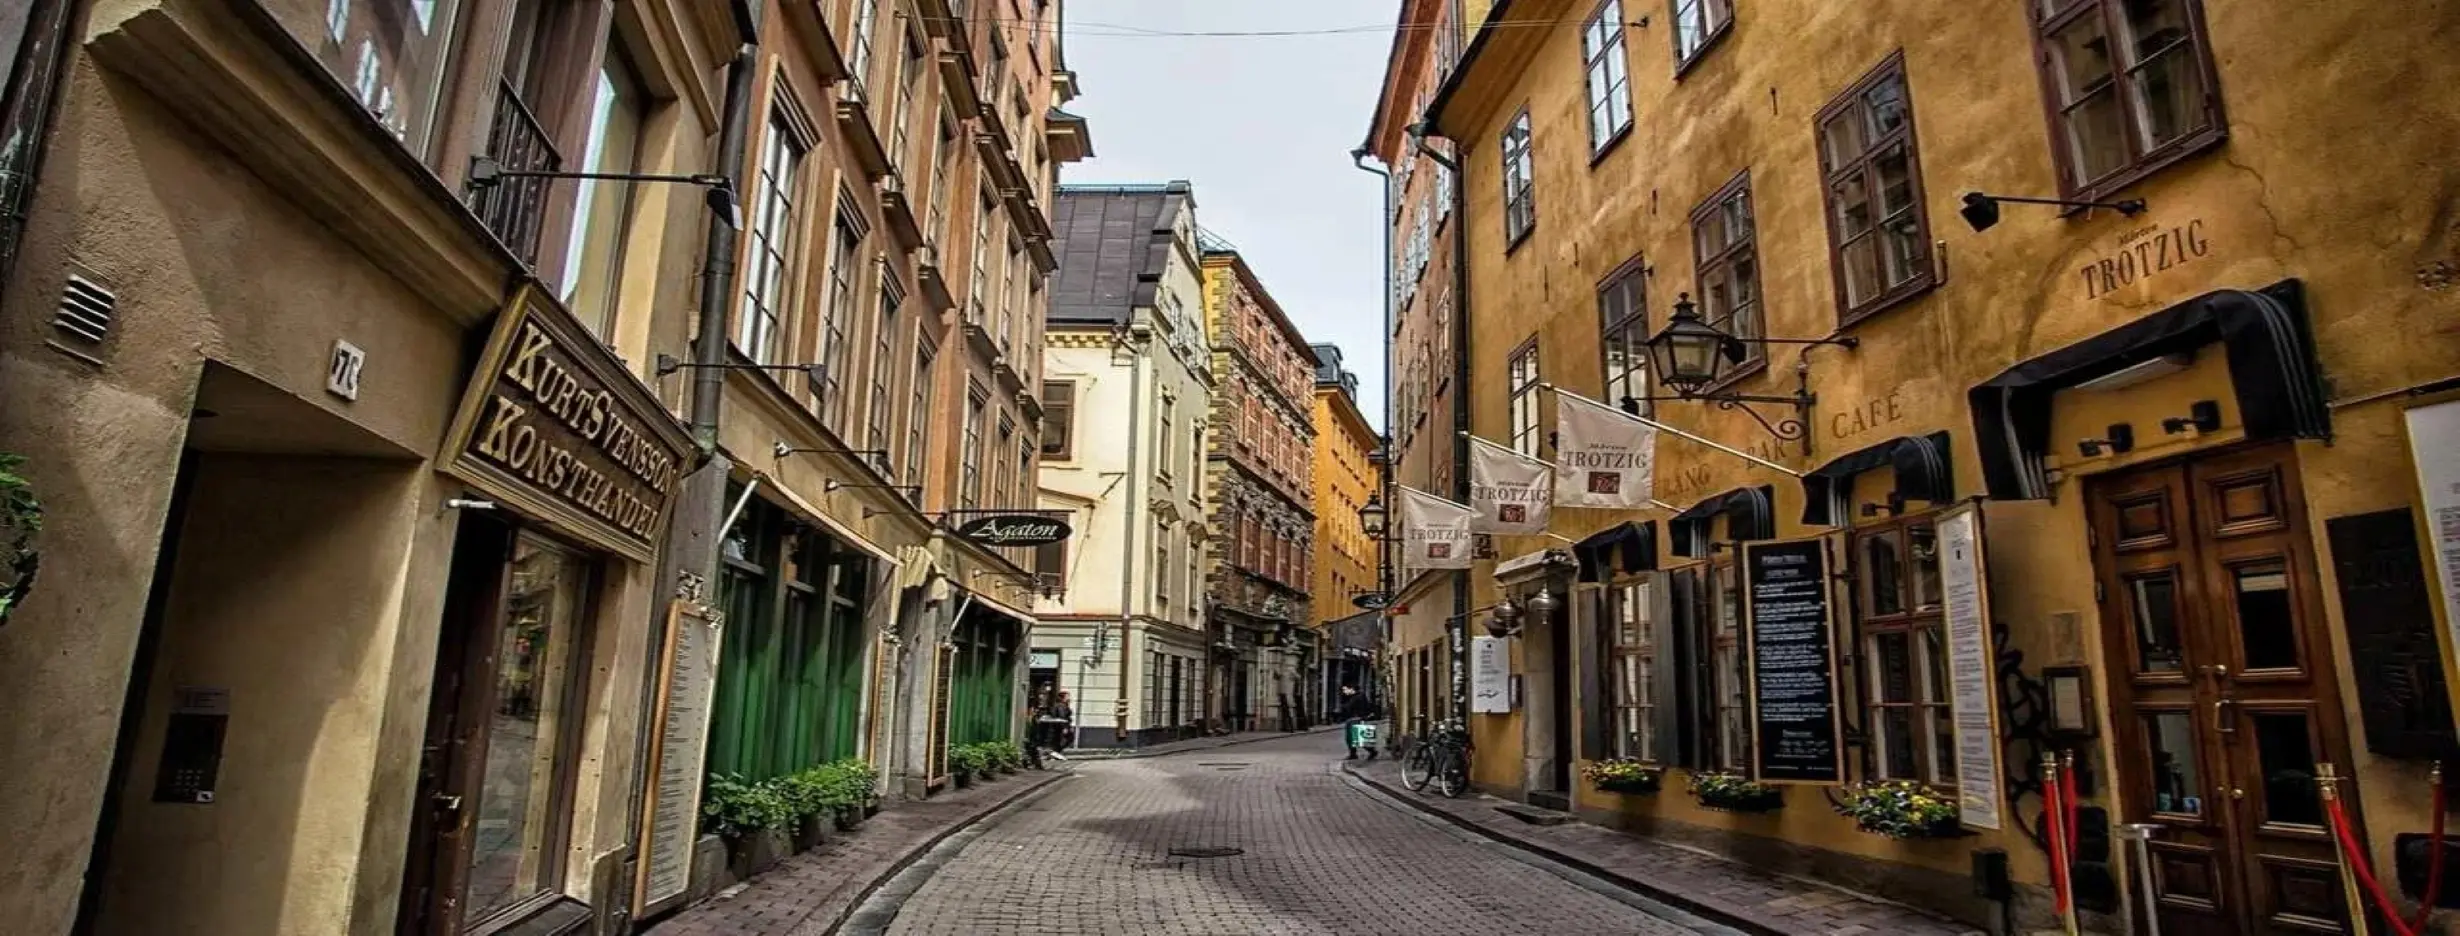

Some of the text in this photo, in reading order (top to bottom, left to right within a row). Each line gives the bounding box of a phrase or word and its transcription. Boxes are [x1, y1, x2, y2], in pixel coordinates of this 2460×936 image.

[2080, 218, 2208, 300] TROTZIG
[479, 395, 658, 537] KONSTHANDEL
[1563, 451, 1648, 469] TROTZIG
[1477, 485, 1548, 502] TROTZIG
[968, 519, 1059, 543] Agaton
[1410, 528, 1469, 540] TROTZIG
